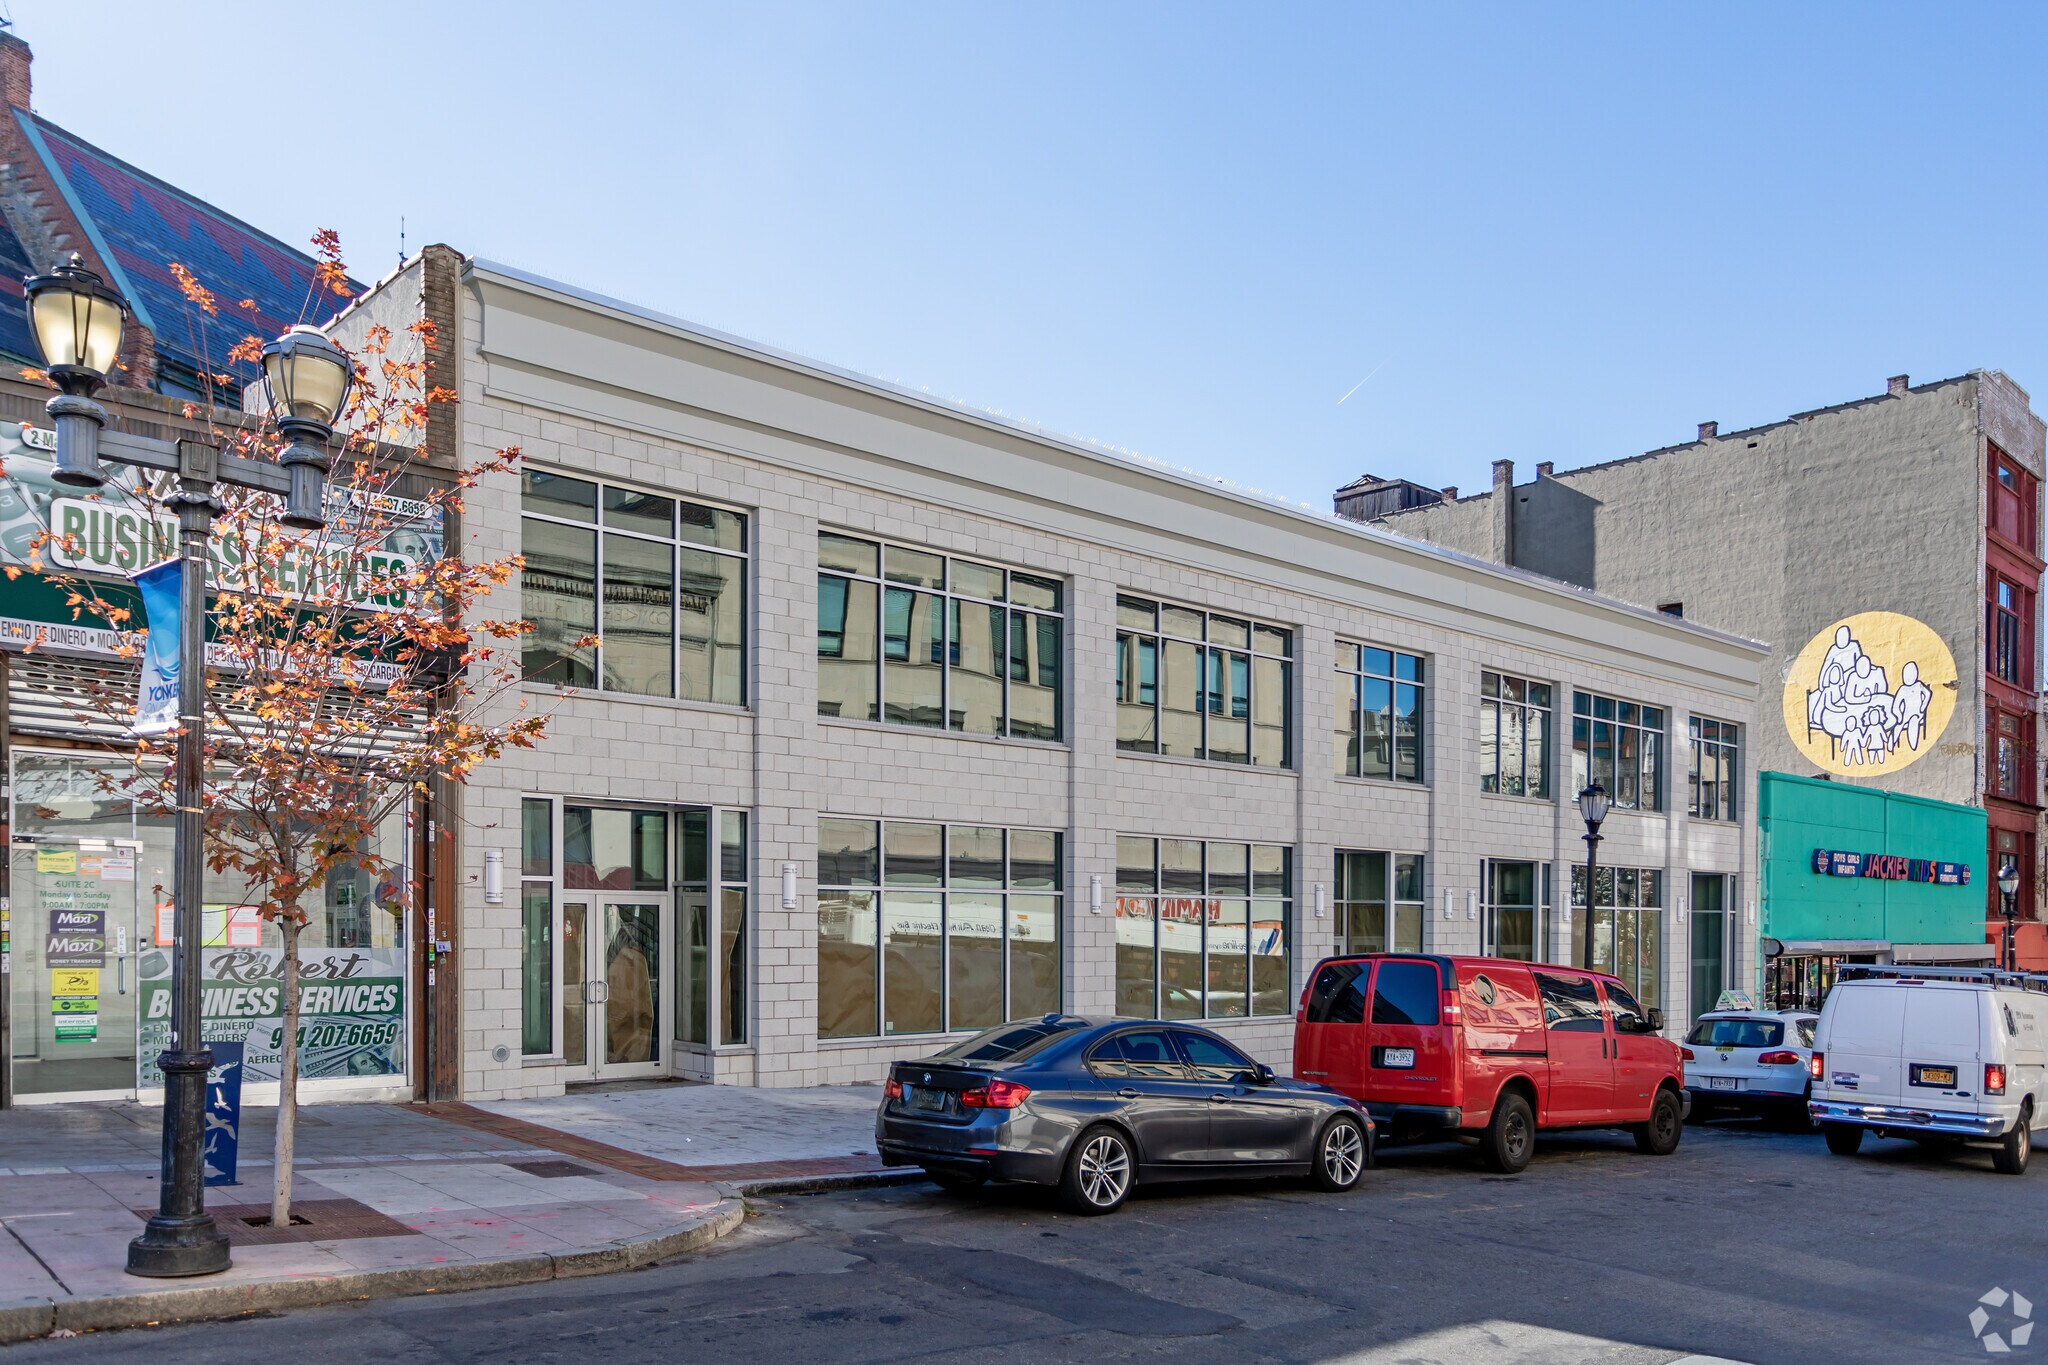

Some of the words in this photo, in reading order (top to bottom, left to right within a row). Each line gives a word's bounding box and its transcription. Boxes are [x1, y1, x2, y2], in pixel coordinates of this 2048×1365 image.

[31, 430, 39, 445] 2
[63, 505, 242, 586] BUSINSS
[51, 626, 87, 647] DINERO
[148, 682, 180, 702] YONKE
[1833, 853, 1846, 863] BOYS
[1847, 854, 1860, 865] GIRLS
[1837, 864, 1856, 875] INFANTS
[1865, 854, 1909, 881] JACKIES
[1914, 859, 1937, 884] KIDS
[84, 881, 95, 889] 2C
[40, 891, 73, 899] Monday
[84, 892, 111, 900] Sunday
[57, 912, 92, 924] Maxi
[48, 938, 95, 953] Maxi
[147, 986, 279, 1019] BINESS
[211, 1021, 255, 1031] DINERO
[308, 1025, 345, 1048] 207
[348, 1023, 399, 1046] 6659
